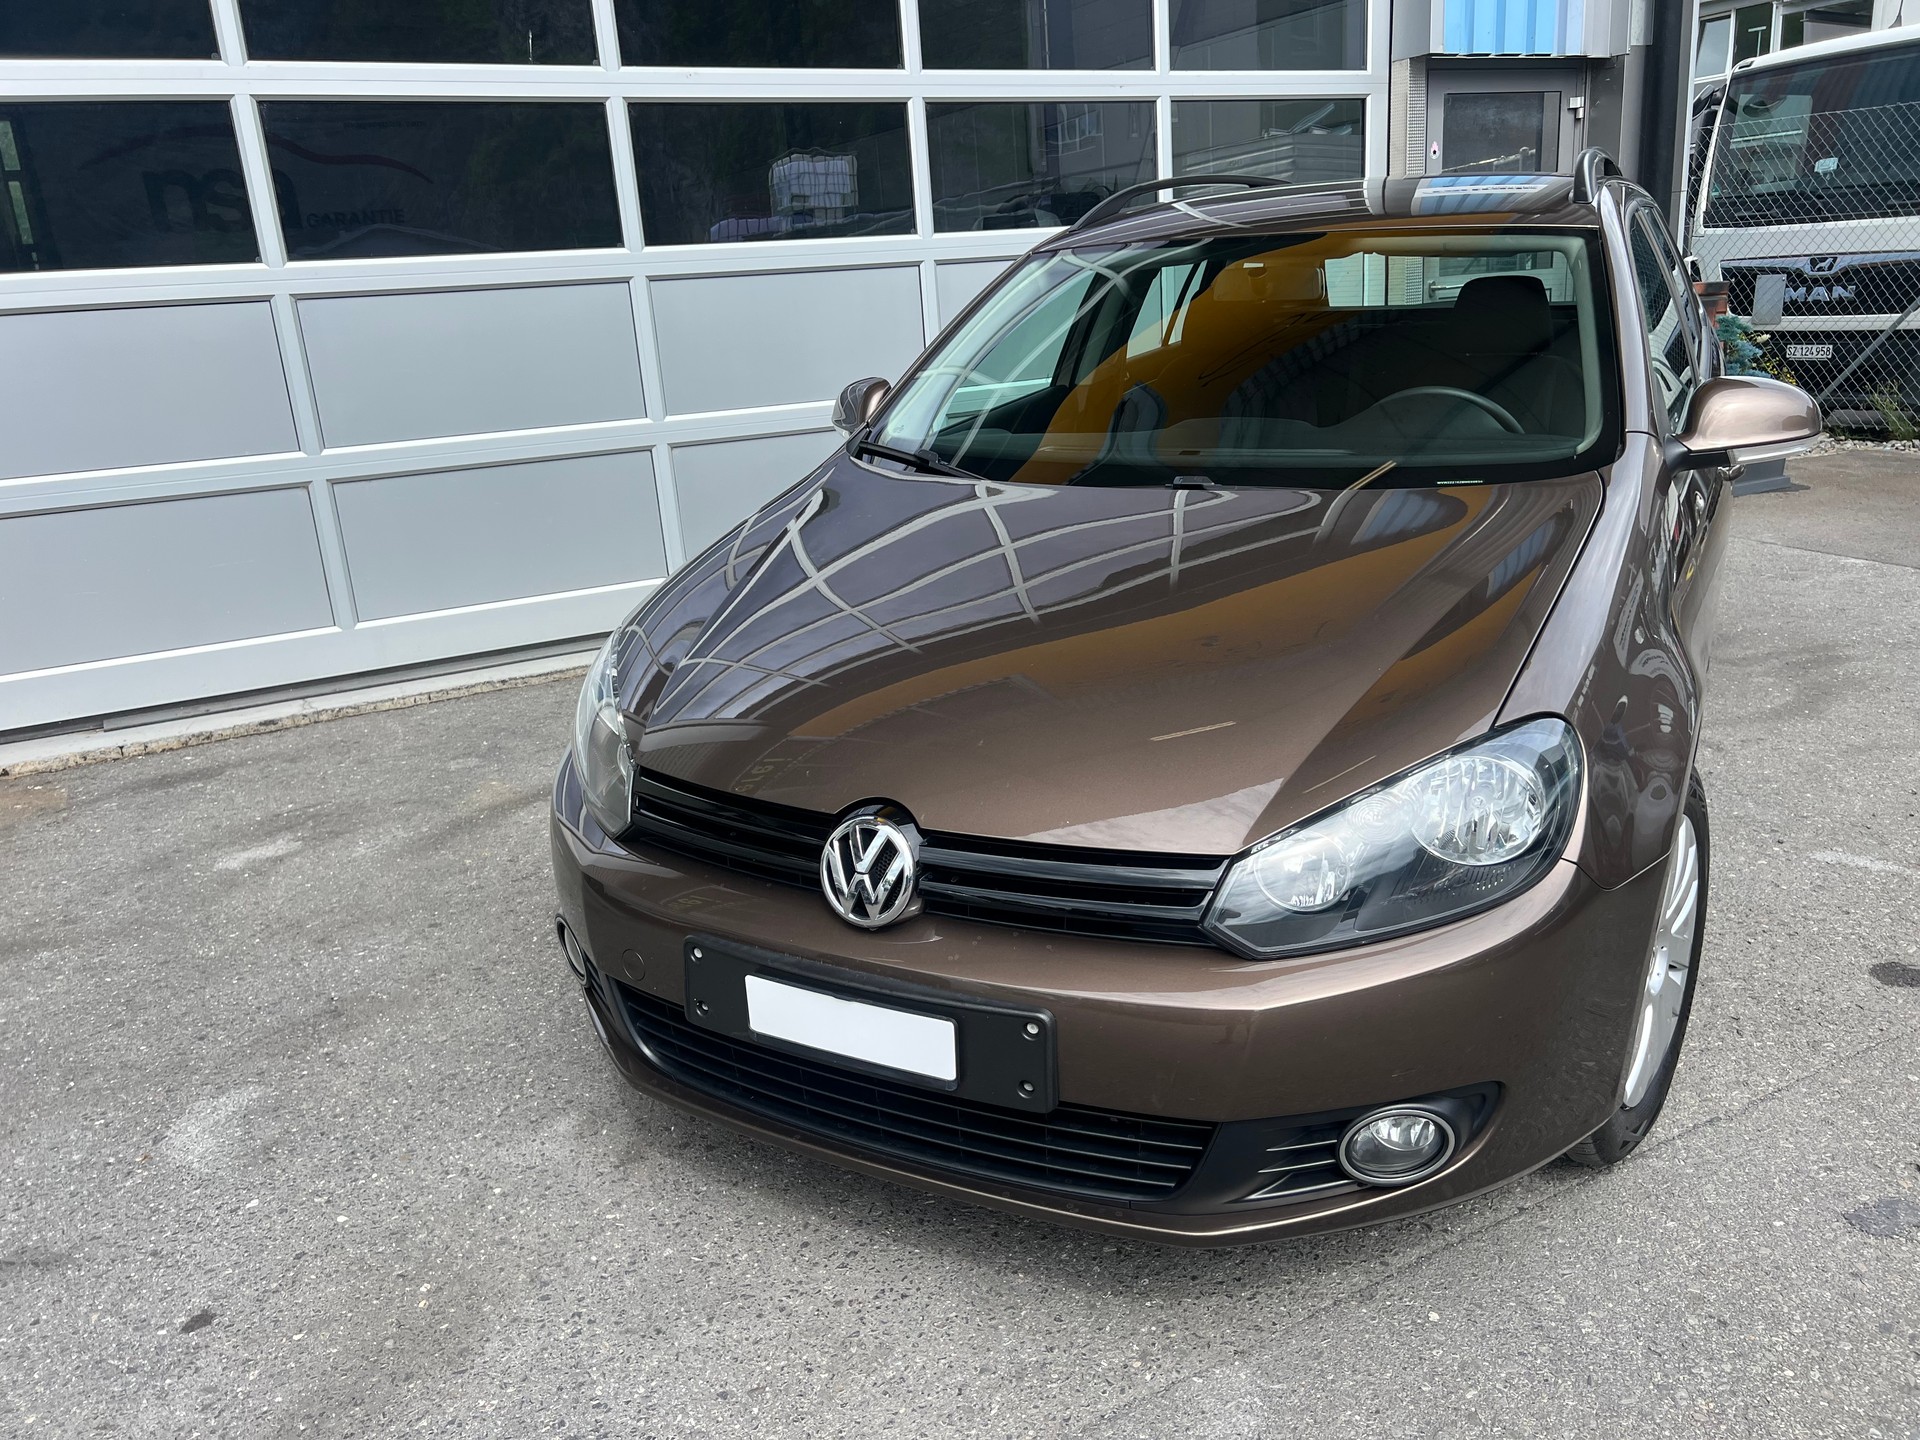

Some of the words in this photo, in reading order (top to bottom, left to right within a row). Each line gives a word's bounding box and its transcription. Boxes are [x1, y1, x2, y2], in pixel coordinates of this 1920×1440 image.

[306, 208, 406, 229] GARANTIE
[1785, 285, 1856, 302] MAN
[1787, 346, 1798, 357] SZ
